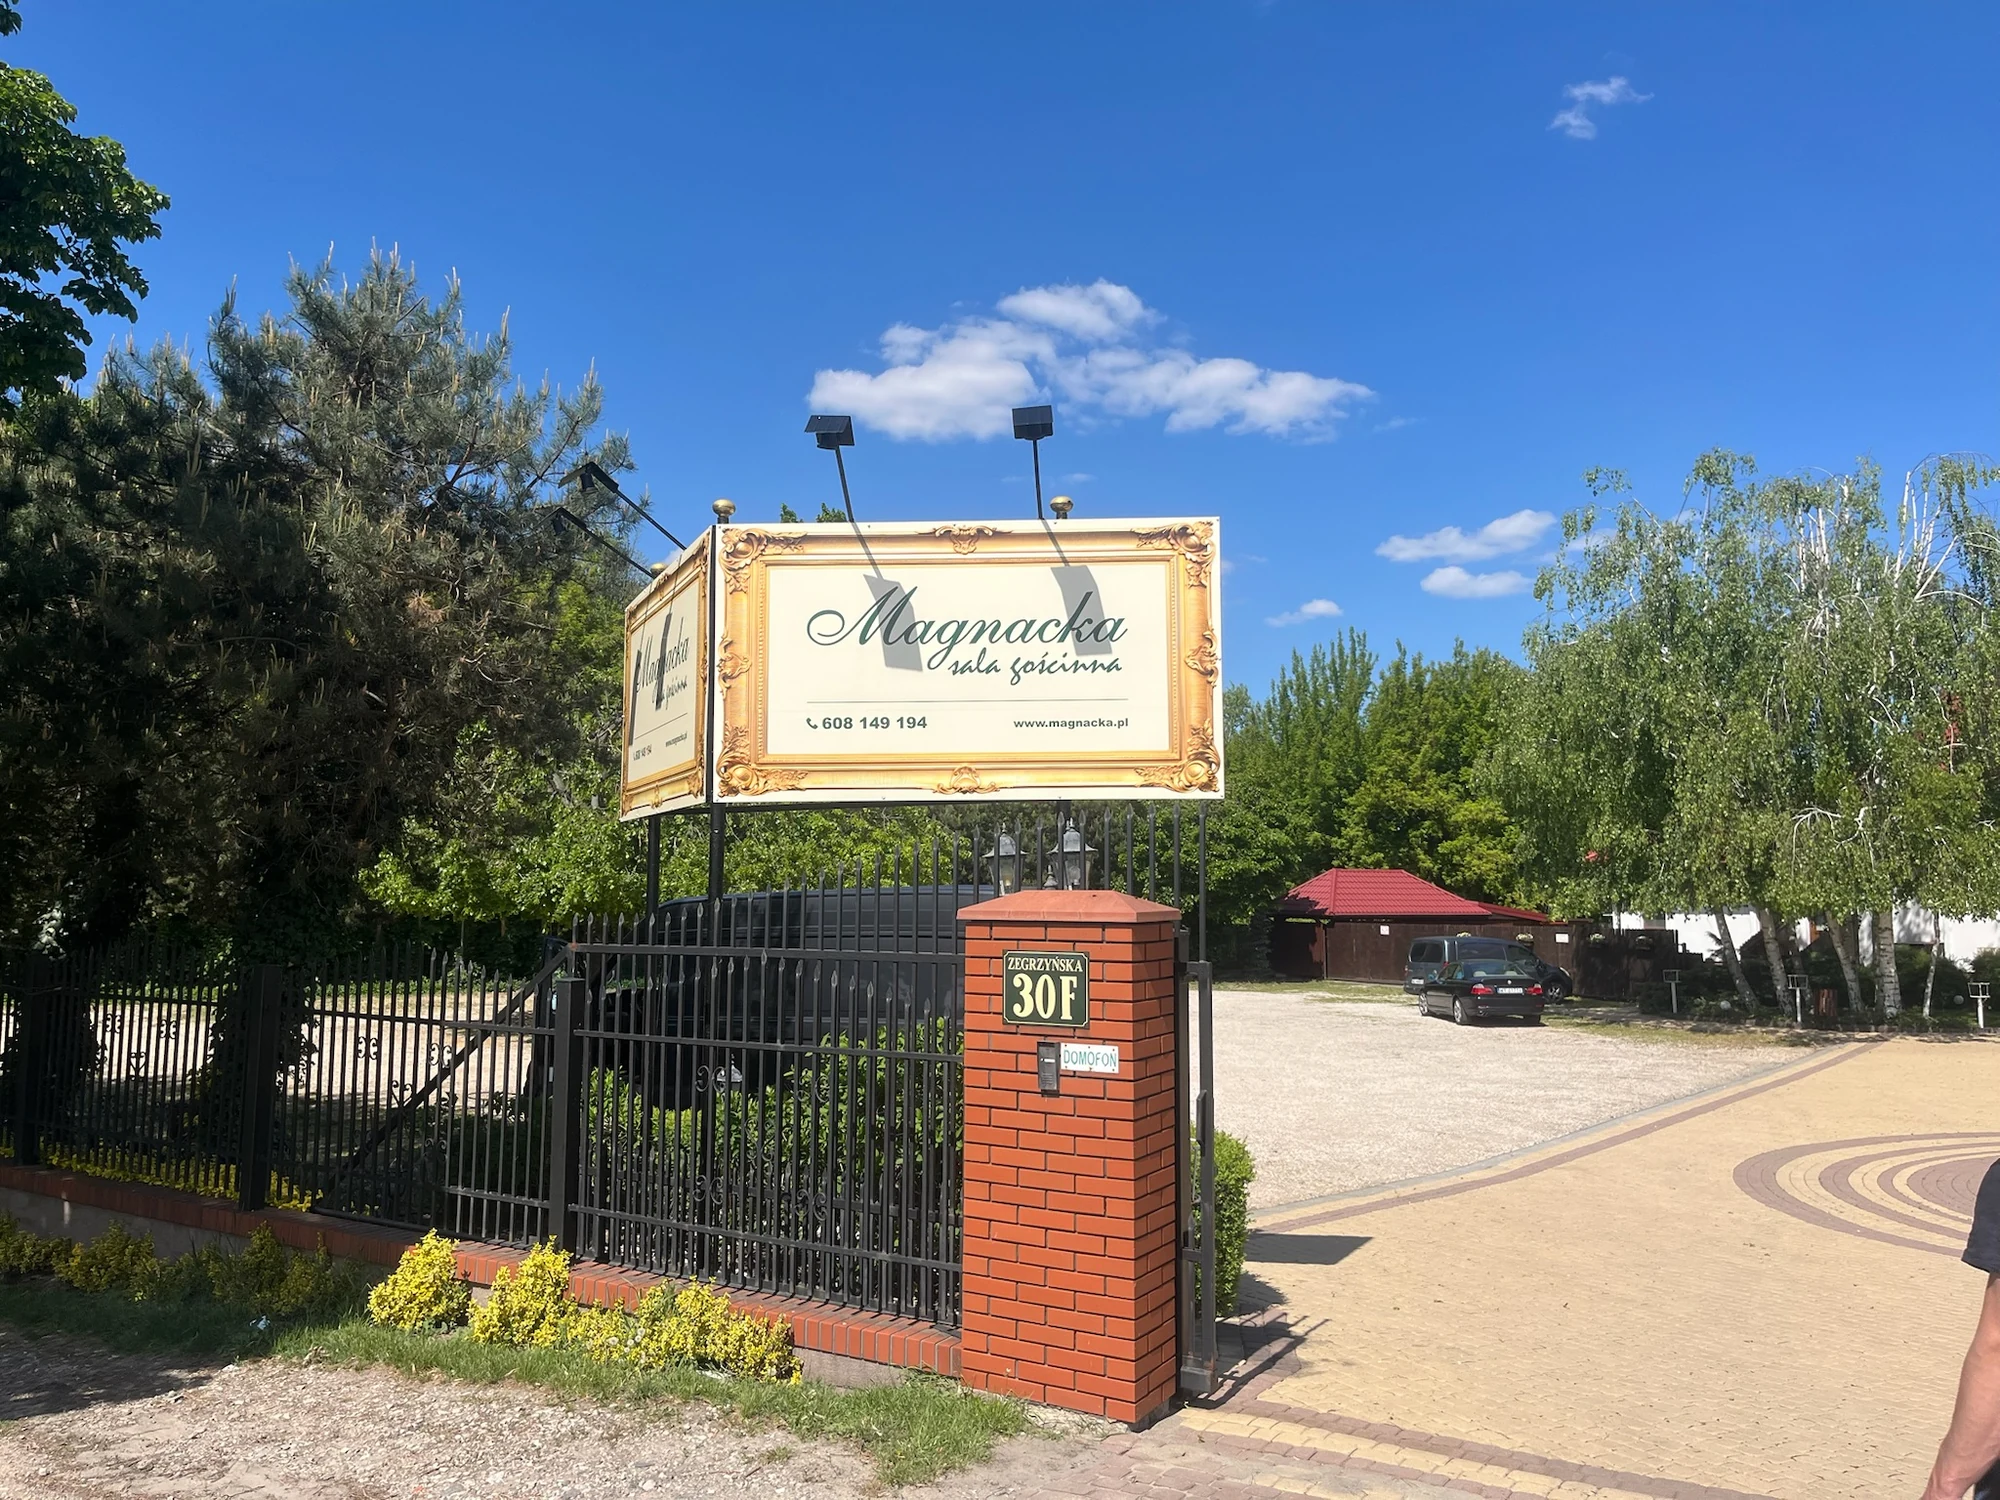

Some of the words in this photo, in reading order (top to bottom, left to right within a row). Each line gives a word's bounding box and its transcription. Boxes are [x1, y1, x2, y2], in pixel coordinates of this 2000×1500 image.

[806, 585, 1129, 670] Magnacka
[948, 646, 1002, 676] sala
[1009, 651, 1124, 686] gościnna
[821, 716, 854, 730] 608
[859, 716, 891, 730] 149
[896, 716, 928, 730] 194
[1013, 717, 1129, 731] www.magnacka.pl
[1007, 956, 1083, 973] ZEGRZYŃSKA
[1012, 972, 1078, 1020] 30F
[1063, 1049, 1117, 1068] DOMOFON
